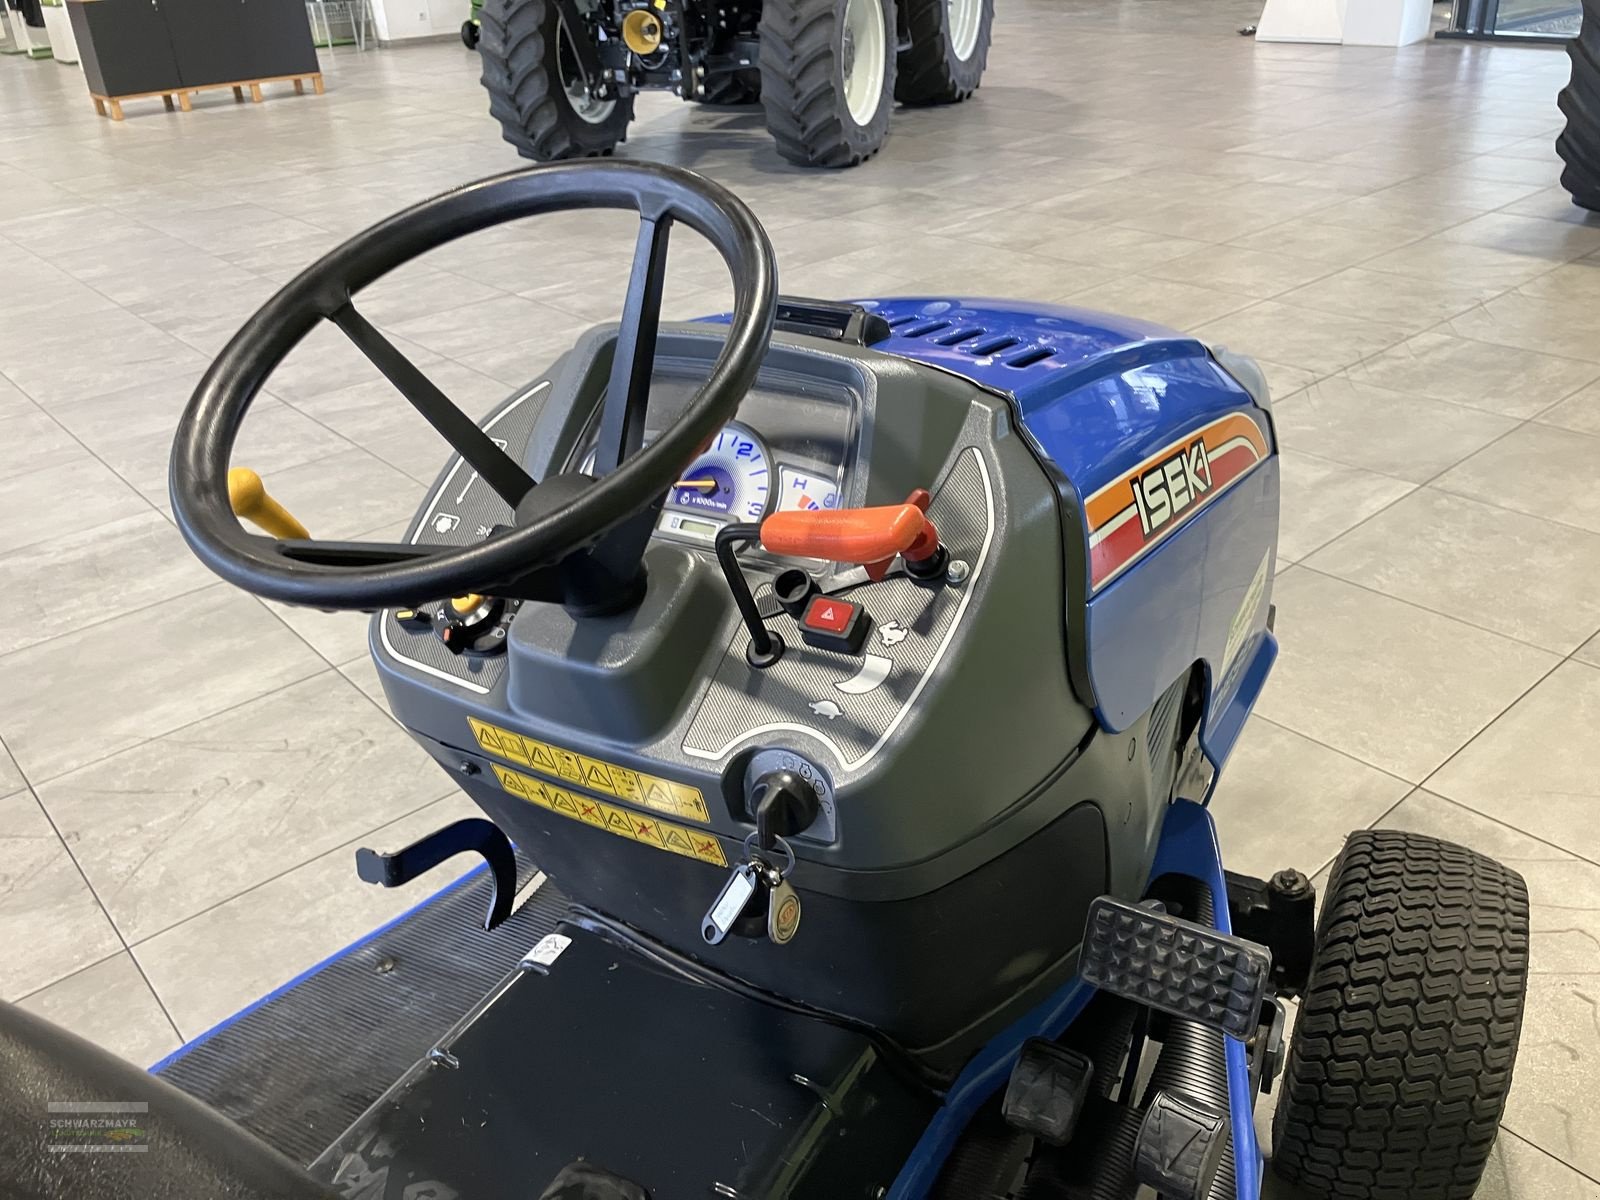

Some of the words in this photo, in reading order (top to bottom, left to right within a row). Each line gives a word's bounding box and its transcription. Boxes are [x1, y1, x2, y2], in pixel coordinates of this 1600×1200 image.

[737, 442, 754, 457] 2
[793, 478, 807, 490] H
[1131, 440, 1213, 537] ISEKI
[748, 503, 763, 516] 3
